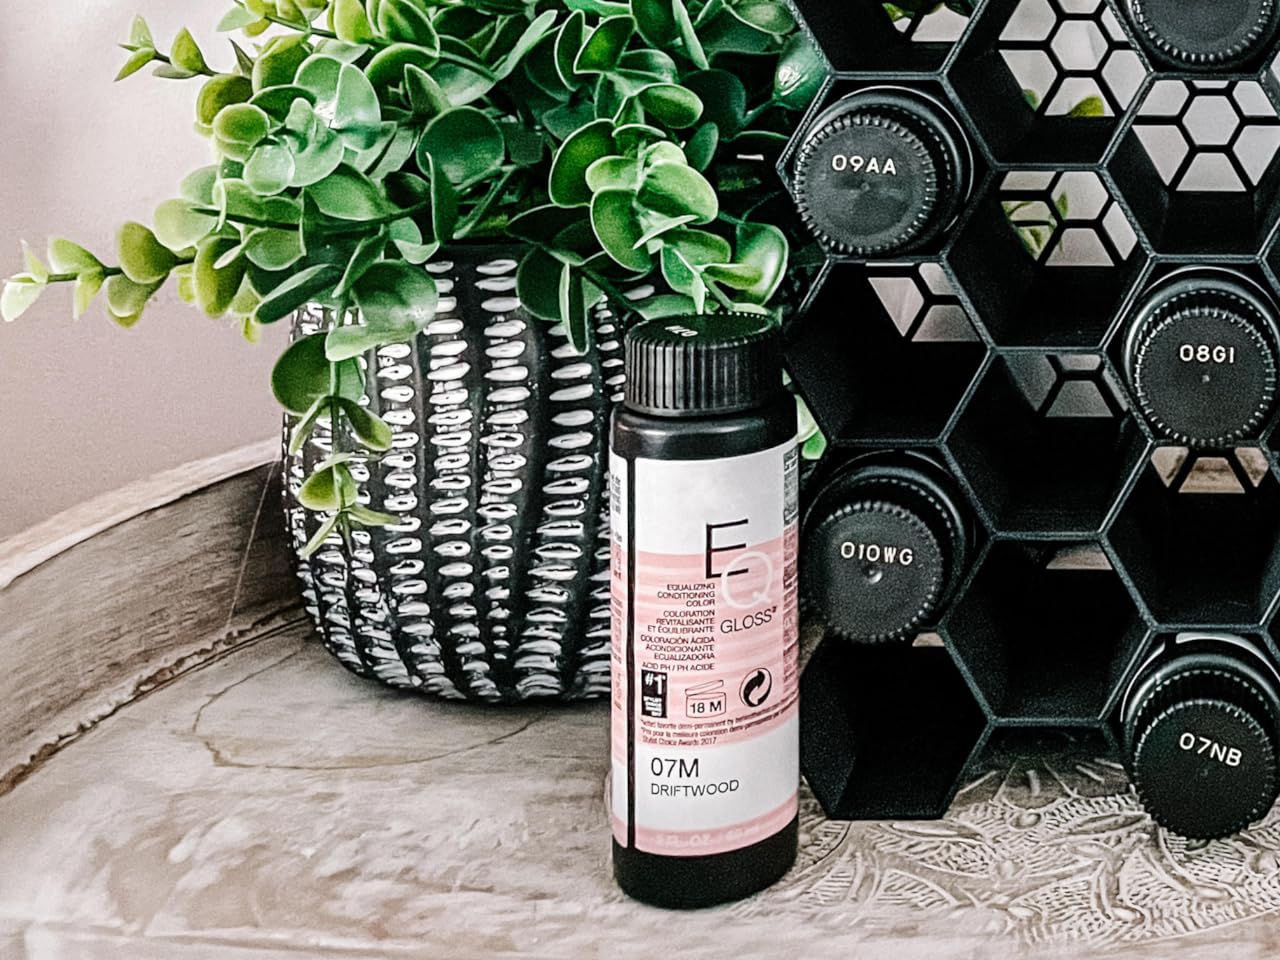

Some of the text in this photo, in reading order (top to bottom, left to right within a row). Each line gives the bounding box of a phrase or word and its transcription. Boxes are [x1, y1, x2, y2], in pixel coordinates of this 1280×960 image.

[832, 153, 897, 176] 09AA
[840, 540, 914, 566] 010WG
[667, 583, 715, 591] EQUALIZING
[657, 591, 715, 599] CONDITIONING
[686, 599, 715, 607] COLOR
[663, 610, 715, 618] COLORATION
[656, 618, 715, 626] REVITALISANTE
[654, 652, 715, 661] ECUALIZADORA
[690, 663, 715, 671] ACIDE
[690, 702, 705, 714] 18
[709, 700, 722, 713] M
[700, 737, 717, 745] 2017
[1179, 731, 1243, 767] 07NB
[651, 757, 699, 778] 07M
[651, 779, 740, 797] DRIFTWOOD
